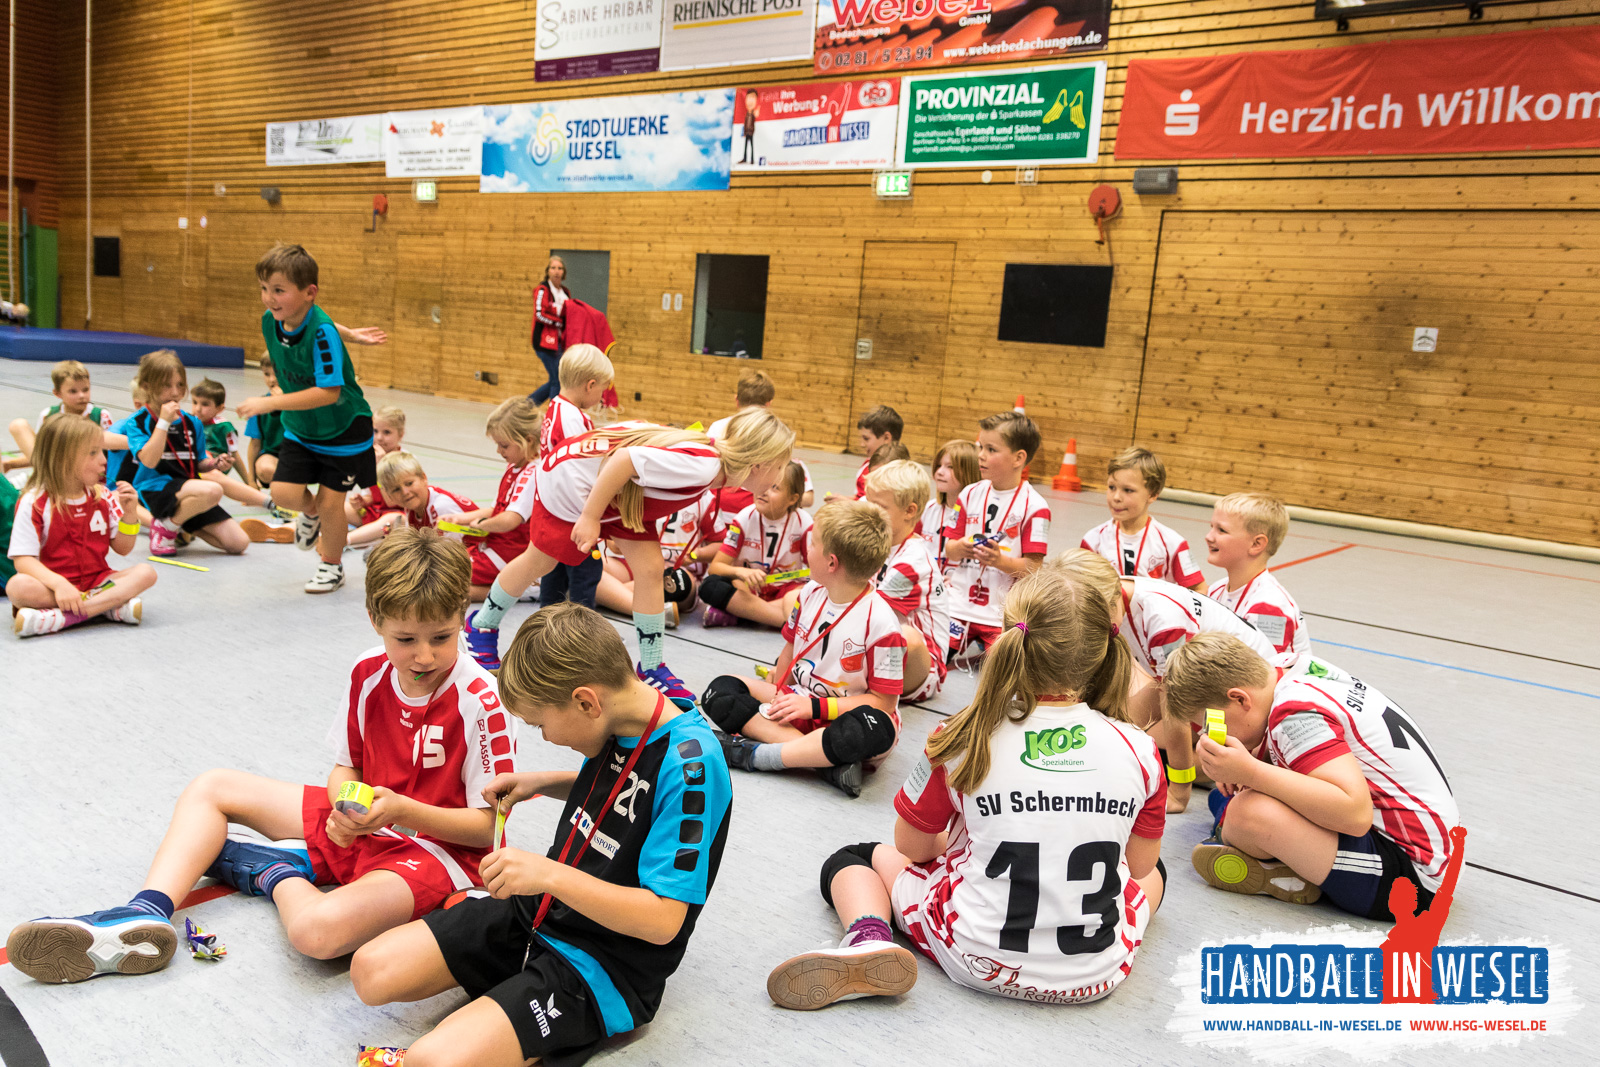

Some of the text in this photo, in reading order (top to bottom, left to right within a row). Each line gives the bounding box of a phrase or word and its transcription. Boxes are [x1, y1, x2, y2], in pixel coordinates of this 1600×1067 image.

[673, 0, 757, 21] RHEINISCHE
[959, 14, 991, 27] GmbH
[829, 27, 890, 39] Bedachungen
[944, 31, 1102, 57] www.weberbedachungen.de
[772, 98, 820, 114] Werbung
[780, 89, 796, 100] Ihre
[915, 82, 1045, 110] PROVINZIAL
[915, 109, 1043, 123] Die Versicherung der Sparkassen
[1239, 84, 1600, 134] Herzlich Willkom
[566, 115, 669, 139] STADTWERKE
[996, 125, 1013, 135] und
[568, 140, 622, 160] WESEL
[89, 510, 107, 536] 4
[766, 532, 779, 558] 7
[413, 724, 446, 769] 15
[479, 734, 491, 774] PLASSON
[1023, 723, 1088, 762] KOS
[1041, 758, 1085, 767] Spezialtüren
[976, 789, 1138, 819] SV Schermbeck
[985, 840, 1122, 956] 13
[990, 984, 1019, 998] Am
[529, 999, 551, 1038] erima
